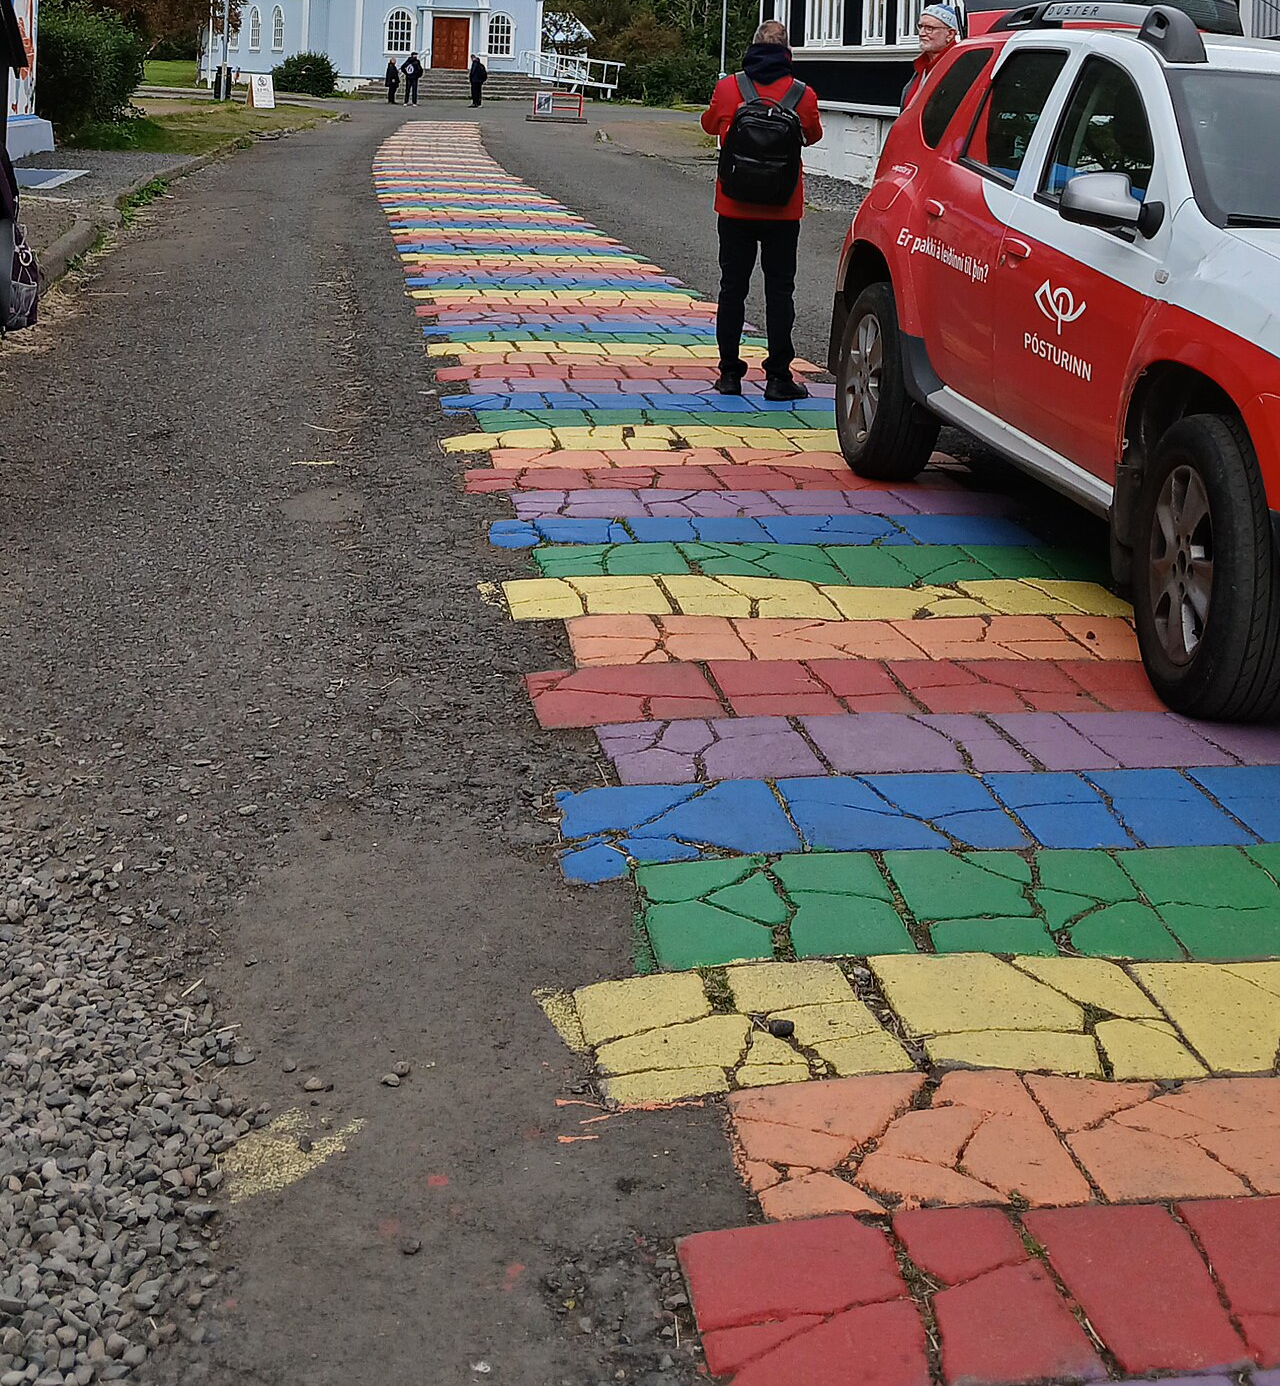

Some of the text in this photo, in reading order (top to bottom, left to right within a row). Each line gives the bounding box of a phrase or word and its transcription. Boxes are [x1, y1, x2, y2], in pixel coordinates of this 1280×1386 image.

[1047, 5, 1100, 16] DUSTER
[896, 227, 913, 247] Er
[911, 236, 936, 257] pakki
[964, 255, 972, 276] til
[971, 258, 989, 283] þín?
[1024, 332, 1092, 382] PÓSTURINN
